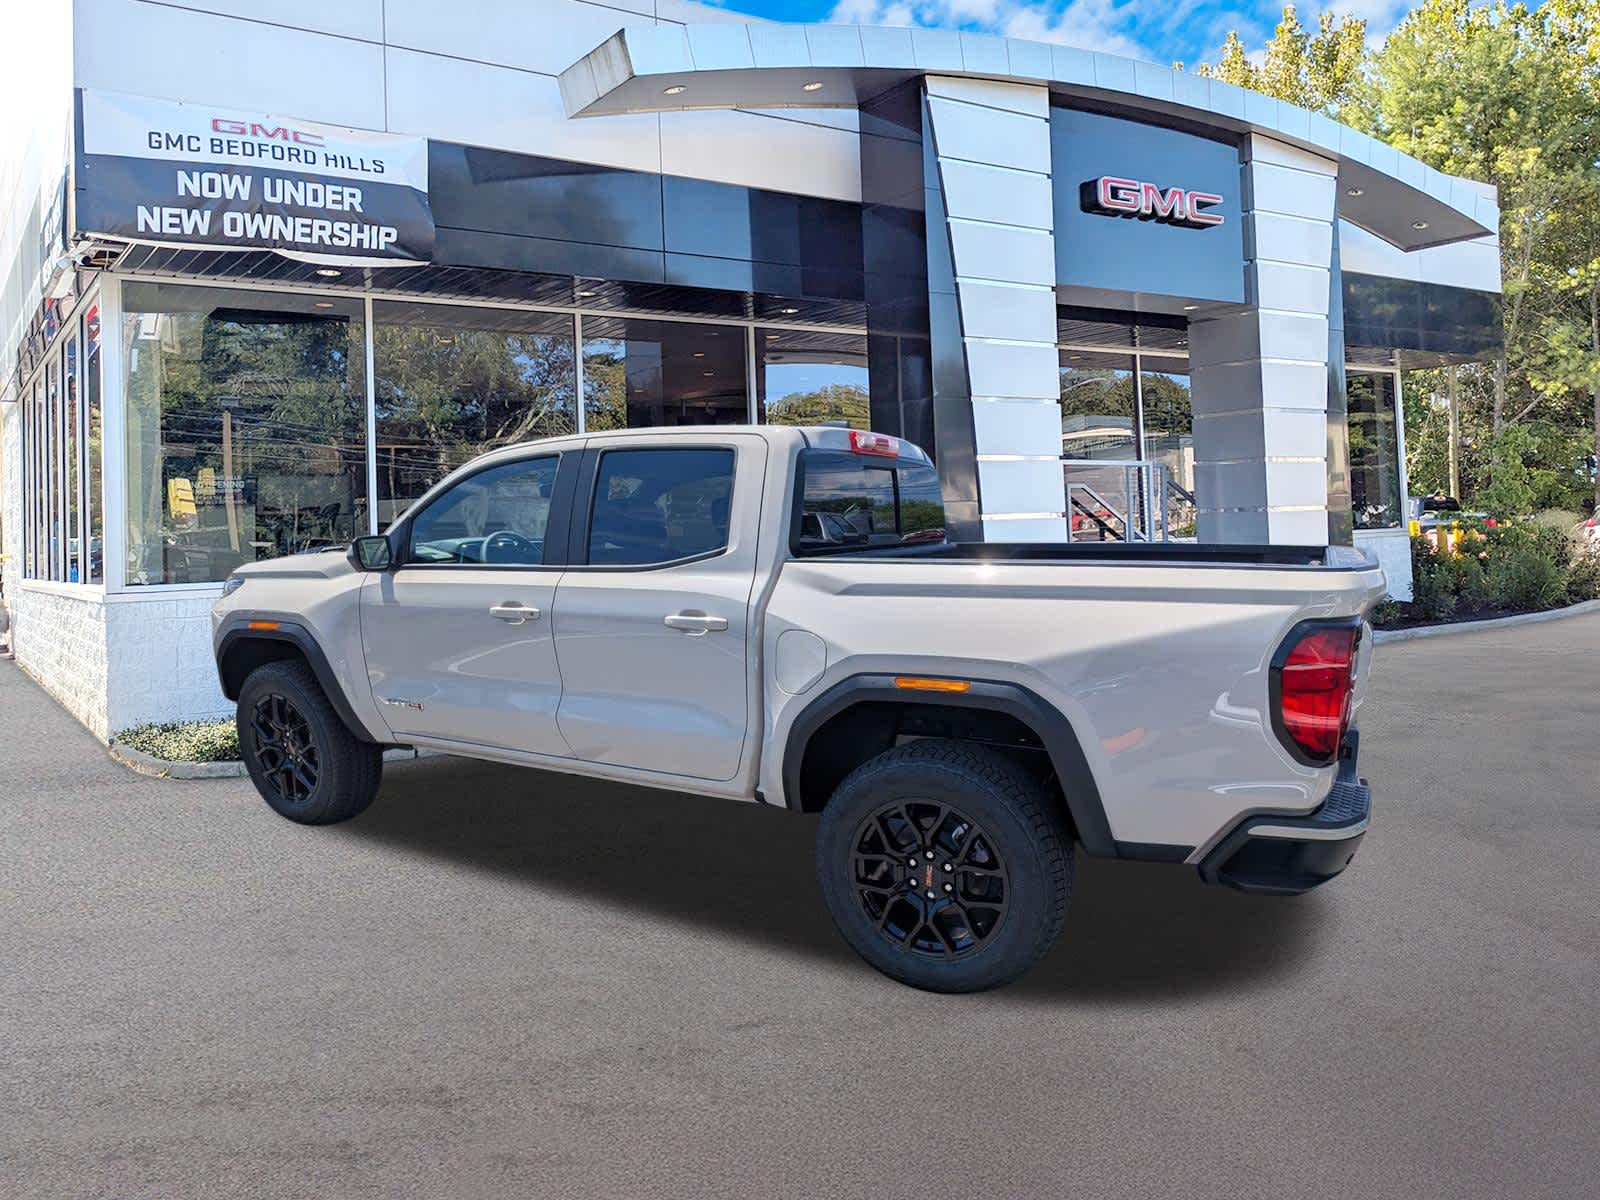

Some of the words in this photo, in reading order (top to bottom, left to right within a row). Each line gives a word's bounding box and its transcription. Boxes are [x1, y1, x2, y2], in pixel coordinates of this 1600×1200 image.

[147, 131, 201, 153] GMC
[209, 137, 317, 165] BEDFORD
[323, 152, 385, 174] HILLS
[211, 118, 326, 148] GMC
[177, 170, 252, 201] NOW
[263, 177, 364, 213] UNDER
[1098, 175, 1225, 225] GMC
[136, 205, 212, 236] NEW
[223, 211, 398, 250] OWNERSHIP
